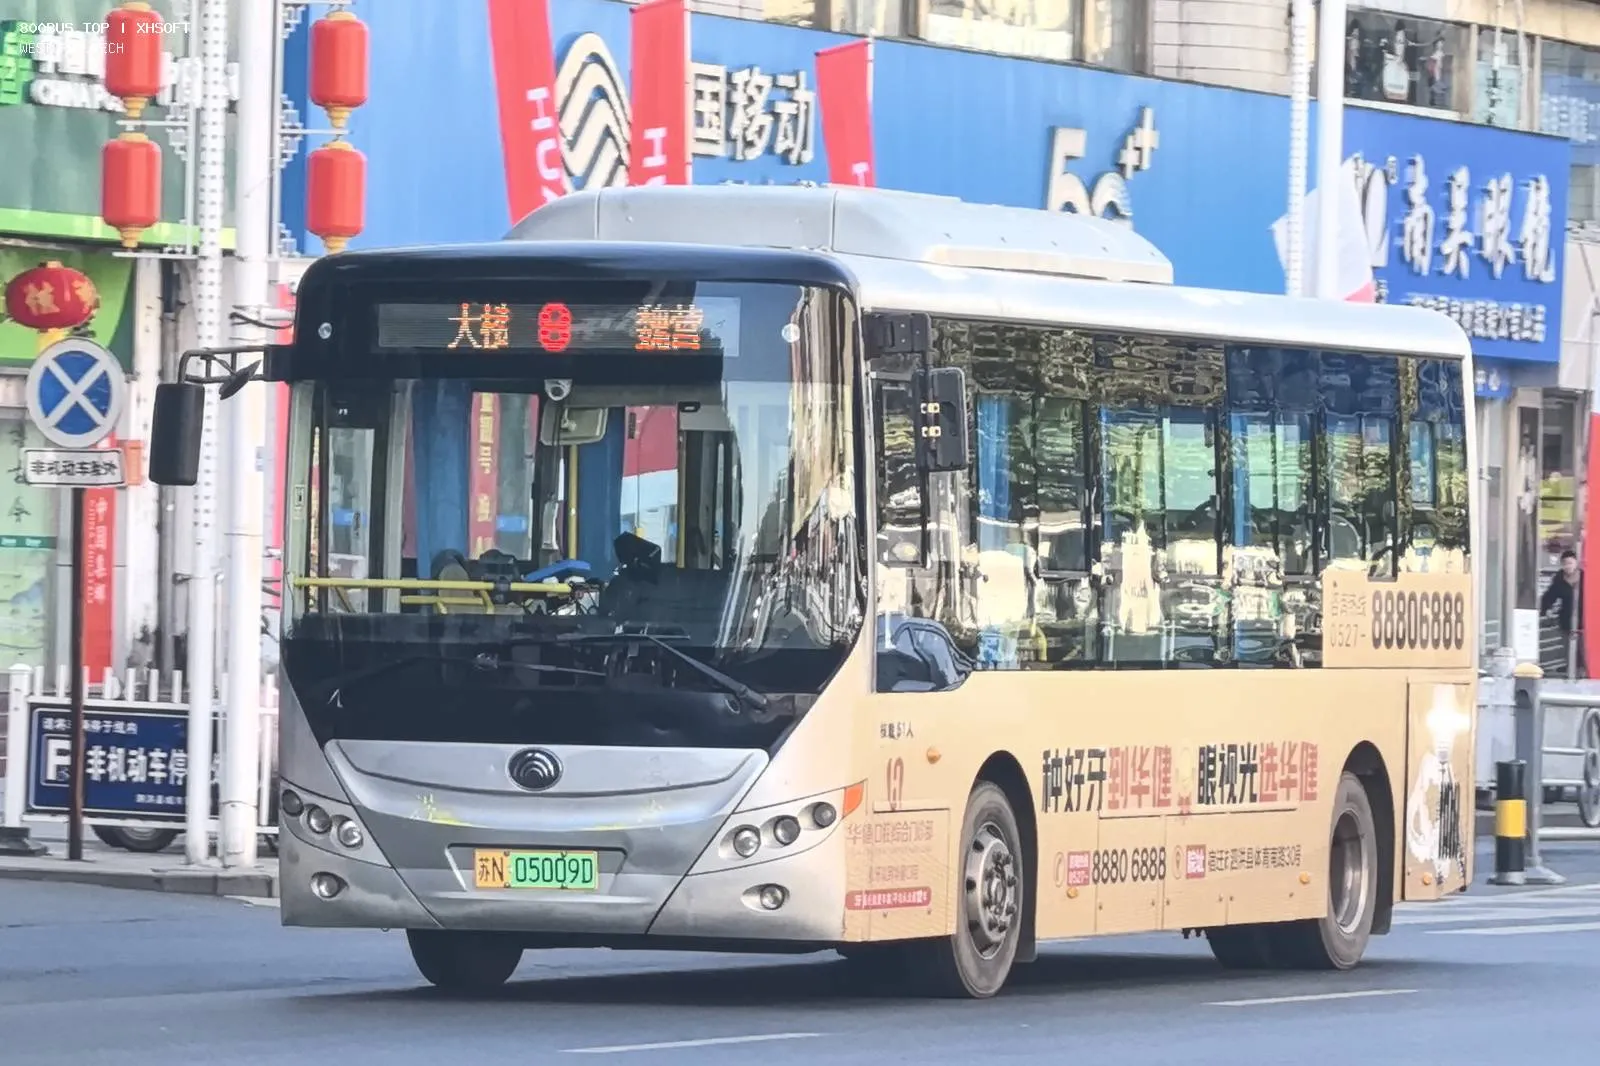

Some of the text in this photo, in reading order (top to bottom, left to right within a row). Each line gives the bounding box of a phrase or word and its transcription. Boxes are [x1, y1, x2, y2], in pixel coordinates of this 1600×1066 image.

[538, 303, 572, 352] 8
[1371, 590, 1465, 650] 88806888
[86, 745, 190, 786] 非机动车停
[515, 857, 593, 884] 05009D
